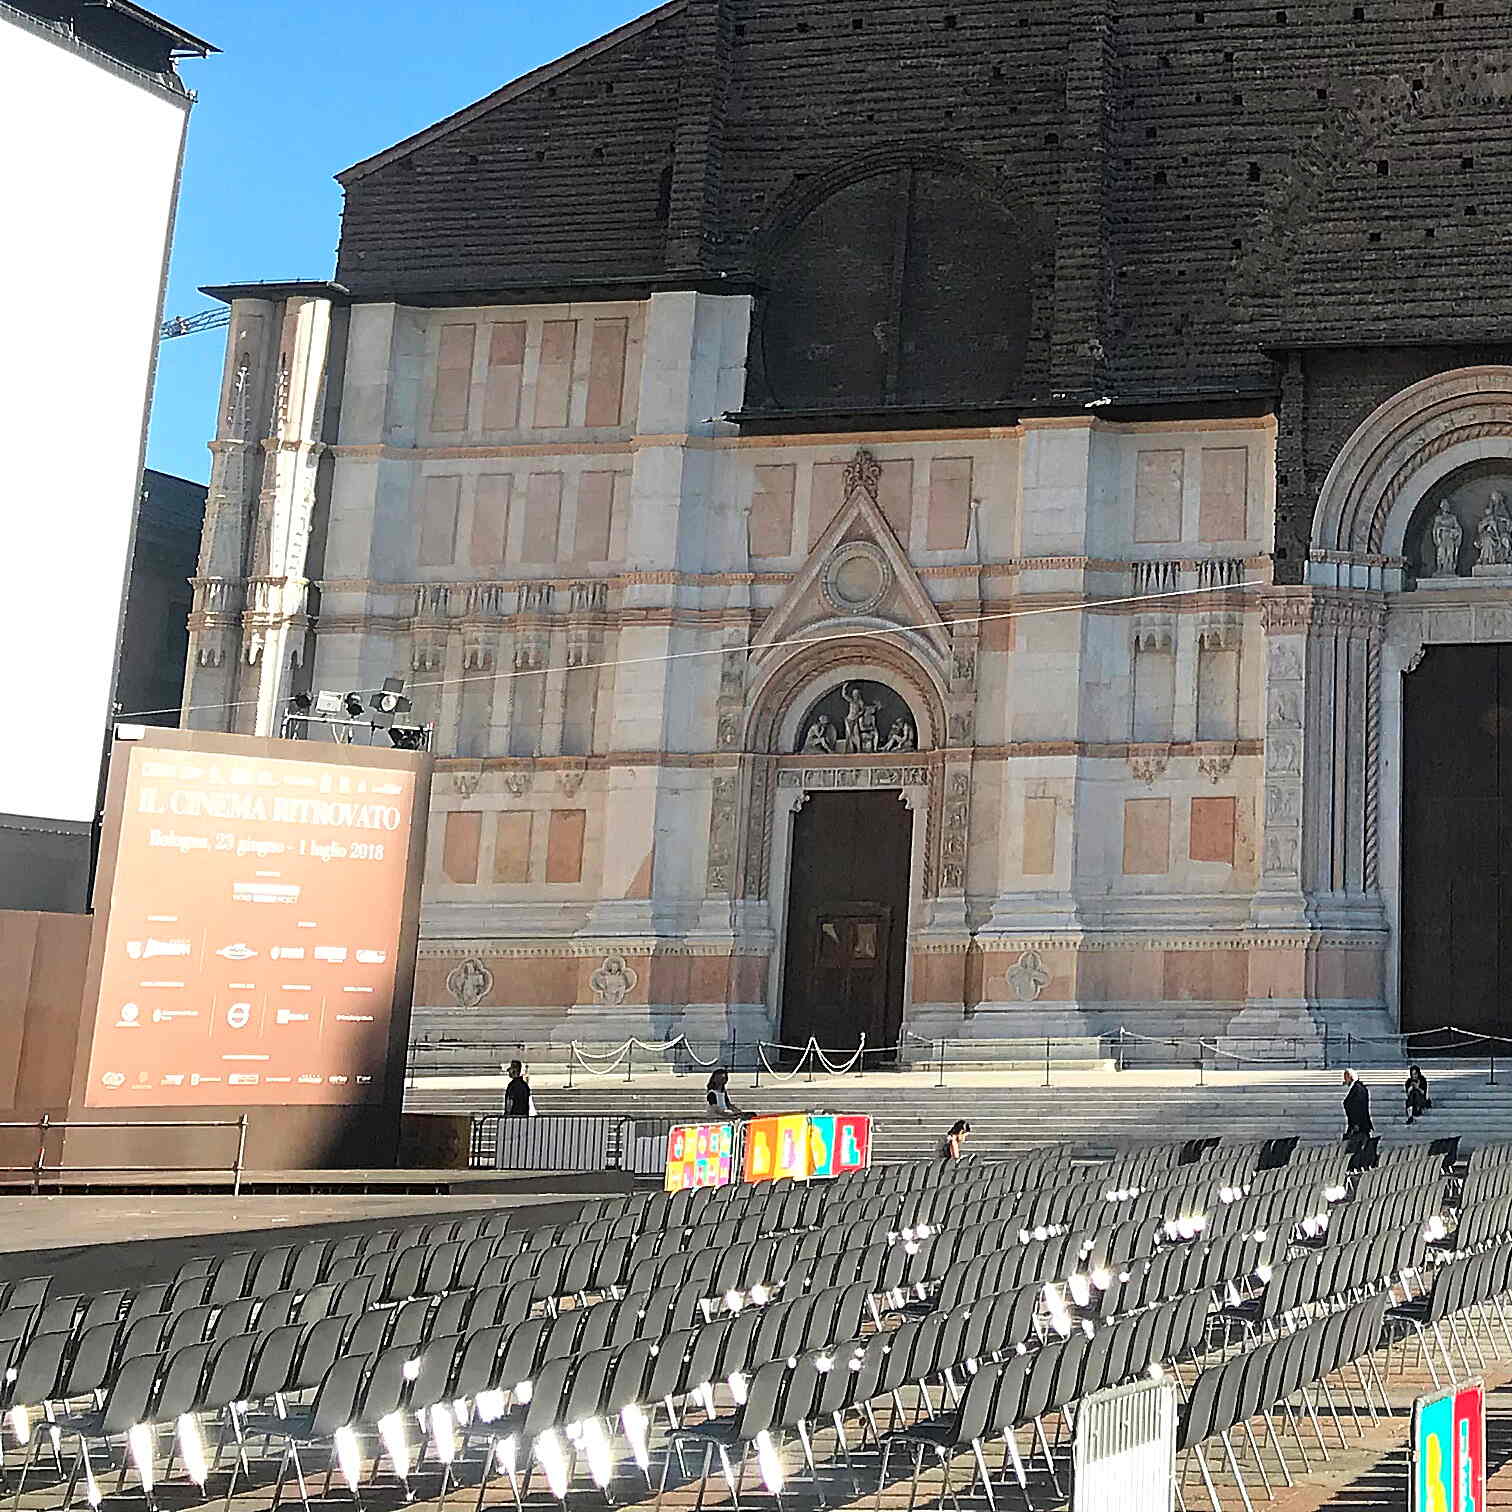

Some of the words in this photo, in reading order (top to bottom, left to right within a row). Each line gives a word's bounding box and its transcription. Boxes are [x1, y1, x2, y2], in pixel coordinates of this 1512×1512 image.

[138, 787, 165, 813] IL
[170, 790, 267, 820] CINEMA
[272, 797, 401, 831] RITROVATO
[348, 842, 385, 861] 2018
